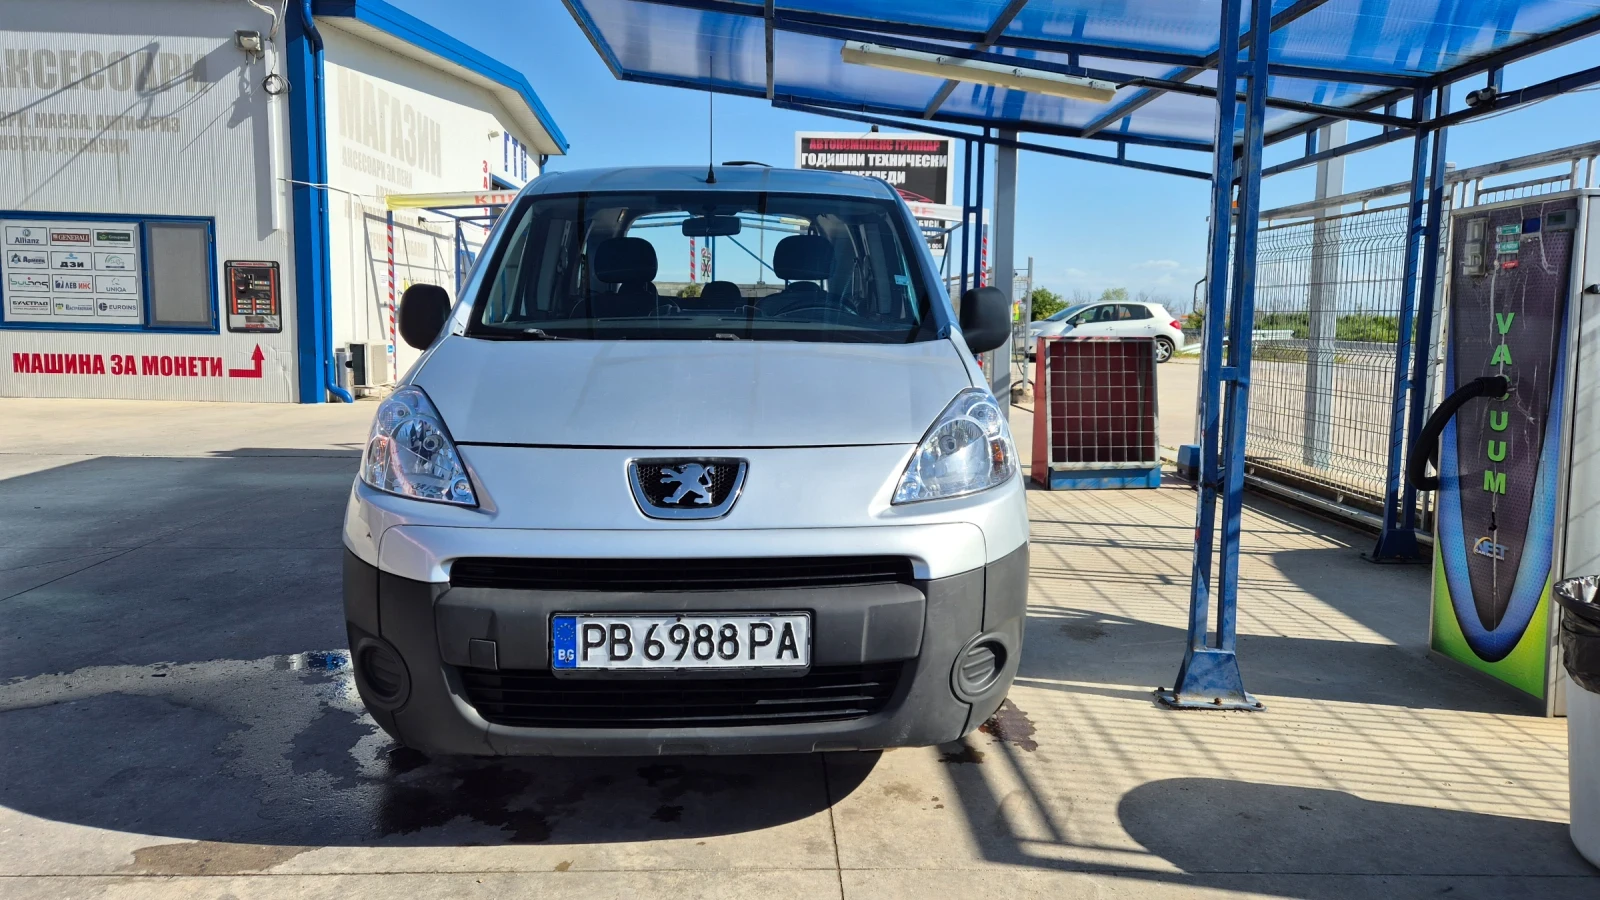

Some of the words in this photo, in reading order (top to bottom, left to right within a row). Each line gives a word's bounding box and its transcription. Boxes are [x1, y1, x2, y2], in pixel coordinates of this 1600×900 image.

[0, 48, 207, 94] КСЕСОАРИ
[336, 65, 443, 178] МАГАЗИН
[801, 153, 865, 167] ГОДИШНИ
[868, 153, 948, 167] ТЕХНИЧЕСКИ
[842, 170, 906, 185] ЛЕДИ
[65, 281, 77, 289] ЛЕВ
[78, 282, 91, 290] ИНС
[12, 353, 106, 375] МАШИНА
[110, 354, 138, 376] ЗА
[141, 355, 223, 377] МОНЕТИ
[580, 623, 634, 662] PB
[643, 623, 740, 662] 6988
[748, 622, 800, 661] PA
[557, 649, 575, 661] BG
